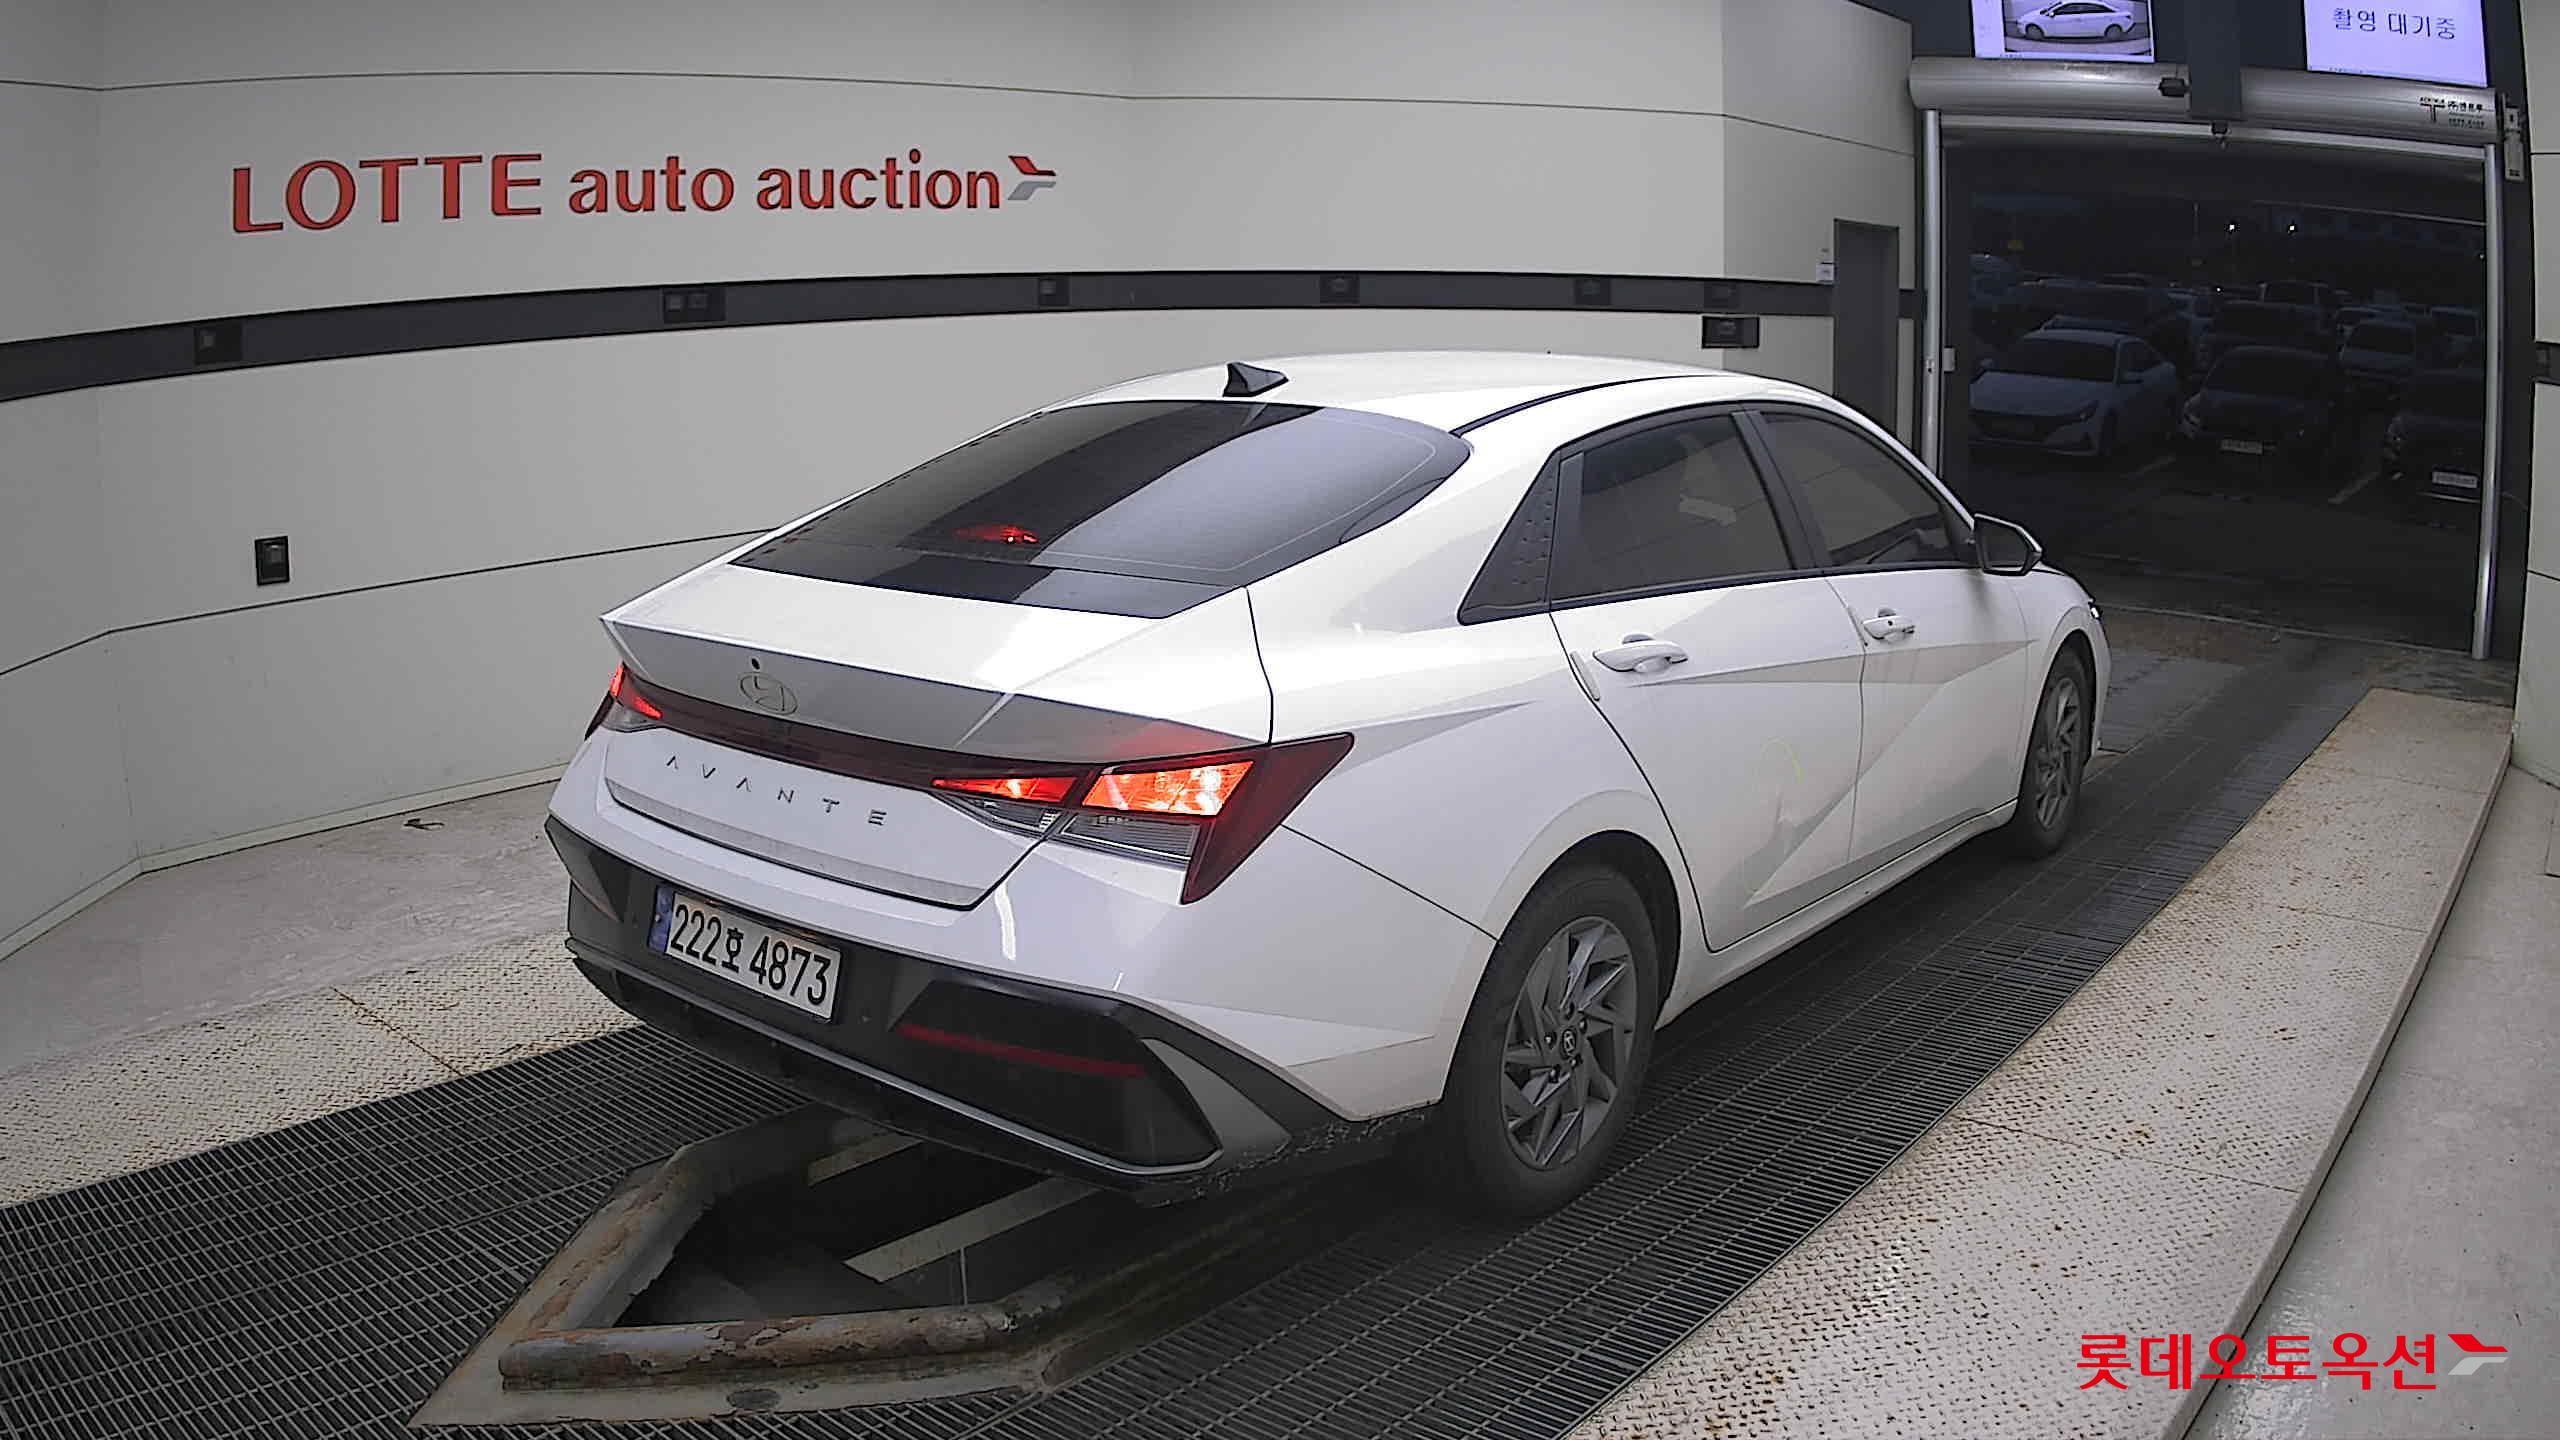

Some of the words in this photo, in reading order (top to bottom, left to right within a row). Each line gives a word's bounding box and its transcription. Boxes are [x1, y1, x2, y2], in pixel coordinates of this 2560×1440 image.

[2334, 8, 2376, 32] 촬영
[2387, 13, 2456, 40] 대기중
[233, 153, 541, 233] LOTTE
[569, 156, 735, 214] auto
[757, 149, 1001, 210] auction
[666, 755, 888, 826] AVANTE
[749, 935, 832, 1006] 4873
